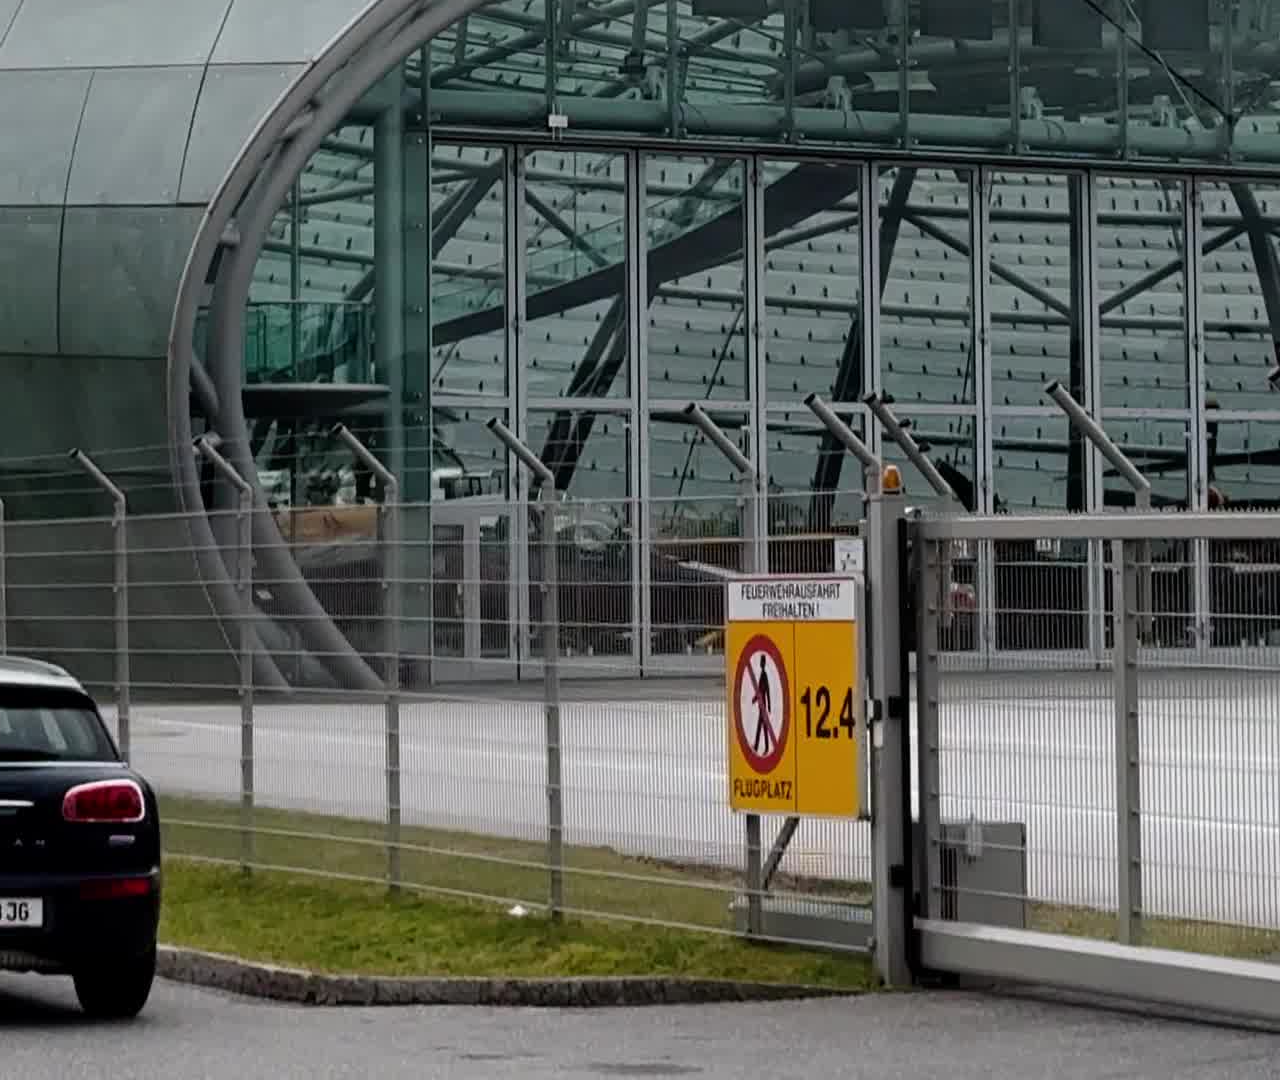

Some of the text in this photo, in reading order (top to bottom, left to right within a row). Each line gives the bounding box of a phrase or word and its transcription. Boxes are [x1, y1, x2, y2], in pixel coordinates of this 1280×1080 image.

[741, 583, 840, 600] FEUERWEHRAUSFAHRT
[800, 686, 856, 739] 12.4
[734, 779, 793, 800] FLUGPLATZ
[6, 902, 29, 921] JG
